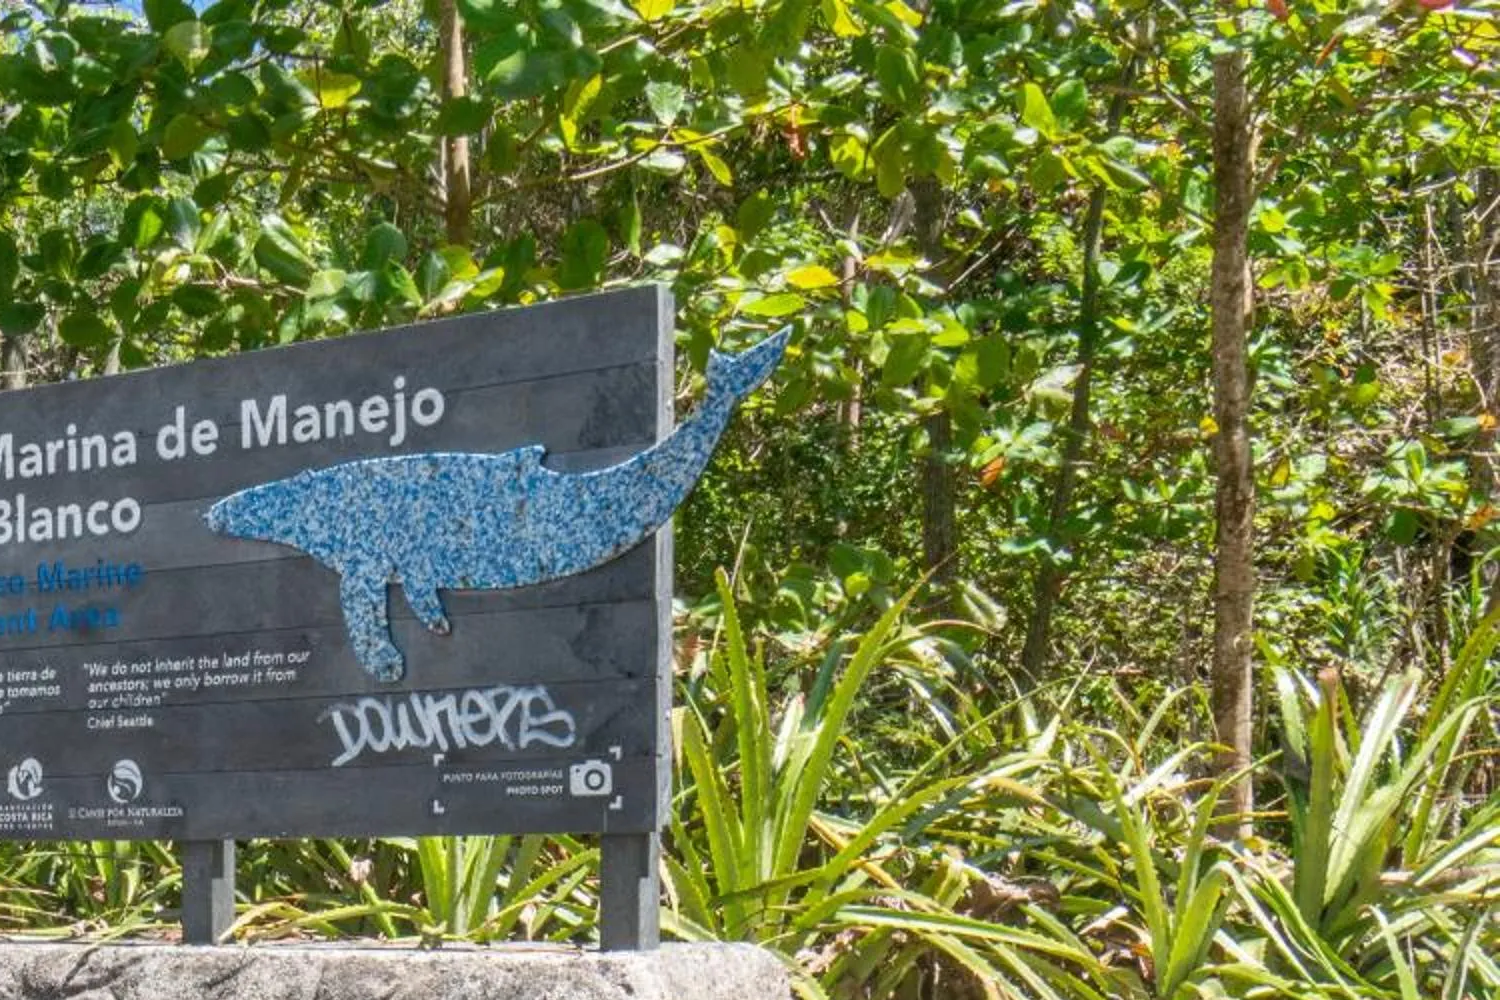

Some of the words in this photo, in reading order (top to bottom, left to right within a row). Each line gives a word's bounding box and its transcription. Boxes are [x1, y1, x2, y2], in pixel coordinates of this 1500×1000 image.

[156, 407, 219, 461] de
[241, 376, 445, 448] Manejo
[37, 559, 143, 593] Marine
[49, 603, 121, 632] Area
[111, 661, 127, 675] do
[131, 660, 151, 674] not
[155, 657, 195, 672] inherit
[198, 655, 219, 669] the
[223, 652, 250, 667] land
[253, 651, 283, 666] from
[287, 651, 311, 663] our
[7, 669, 37, 681] tierra
[40, 667, 56, 680] de
[153, 677, 171, 689] we
[175, 674, 200, 691] only
[203, 672, 250, 687] borrow
[253, 670, 262, 684] it
[266, 667, 297, 682] from
[7, 684, 60, 698] tomamos
[87, 698, 108, 710] our
[87, 715, 115, 729] Chief
[117, 714, 154, 728] Seattle
[31, 811, 53, 822] RICA
